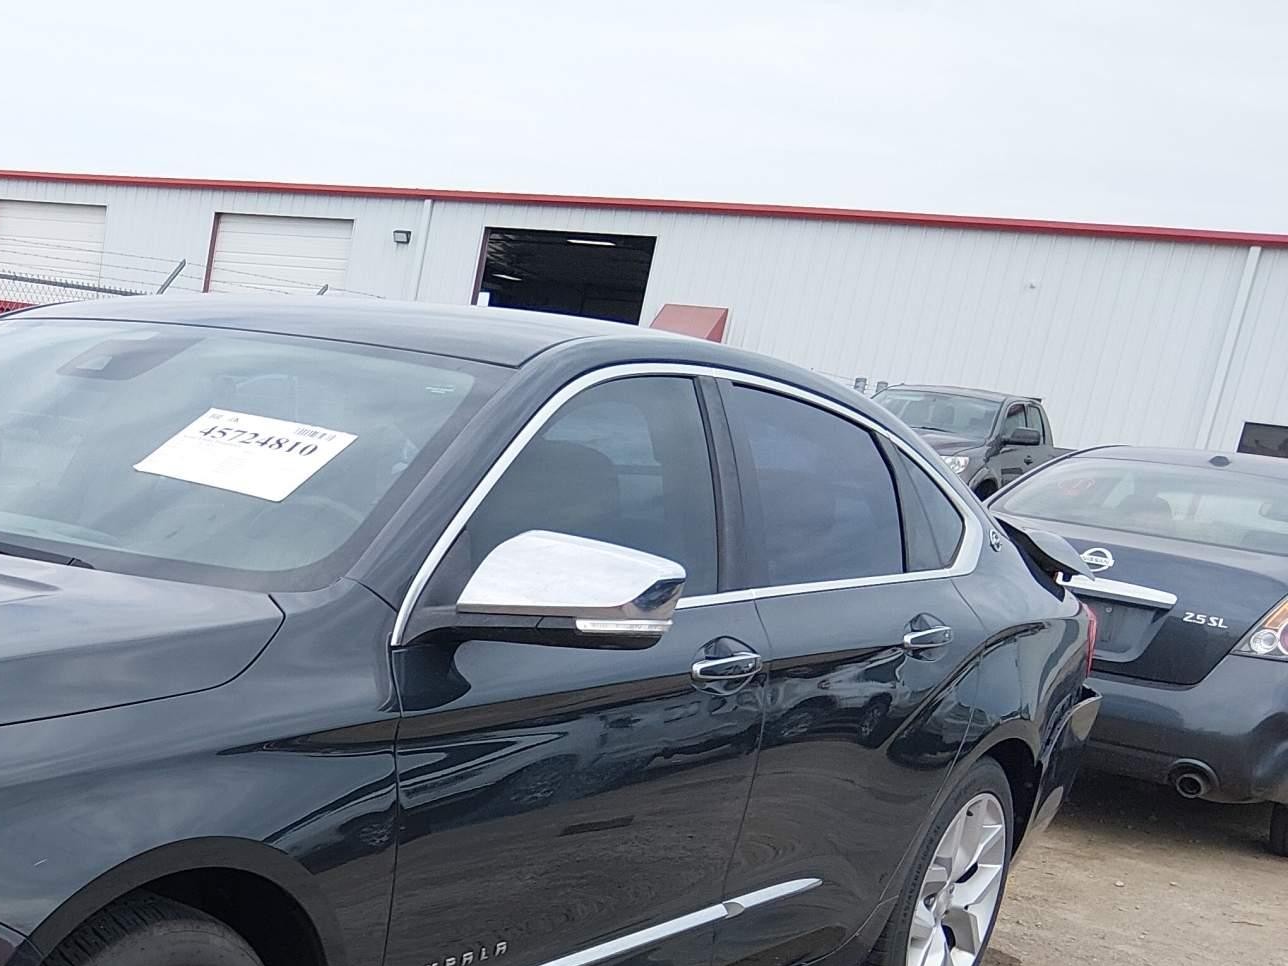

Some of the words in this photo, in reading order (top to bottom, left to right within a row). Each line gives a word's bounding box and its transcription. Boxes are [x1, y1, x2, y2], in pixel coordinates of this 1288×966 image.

[199, 425, 319, 457] 45724810
[1082, 555, 1110, 566] NISSAN
[1207, 616, 1229, 629] SL
